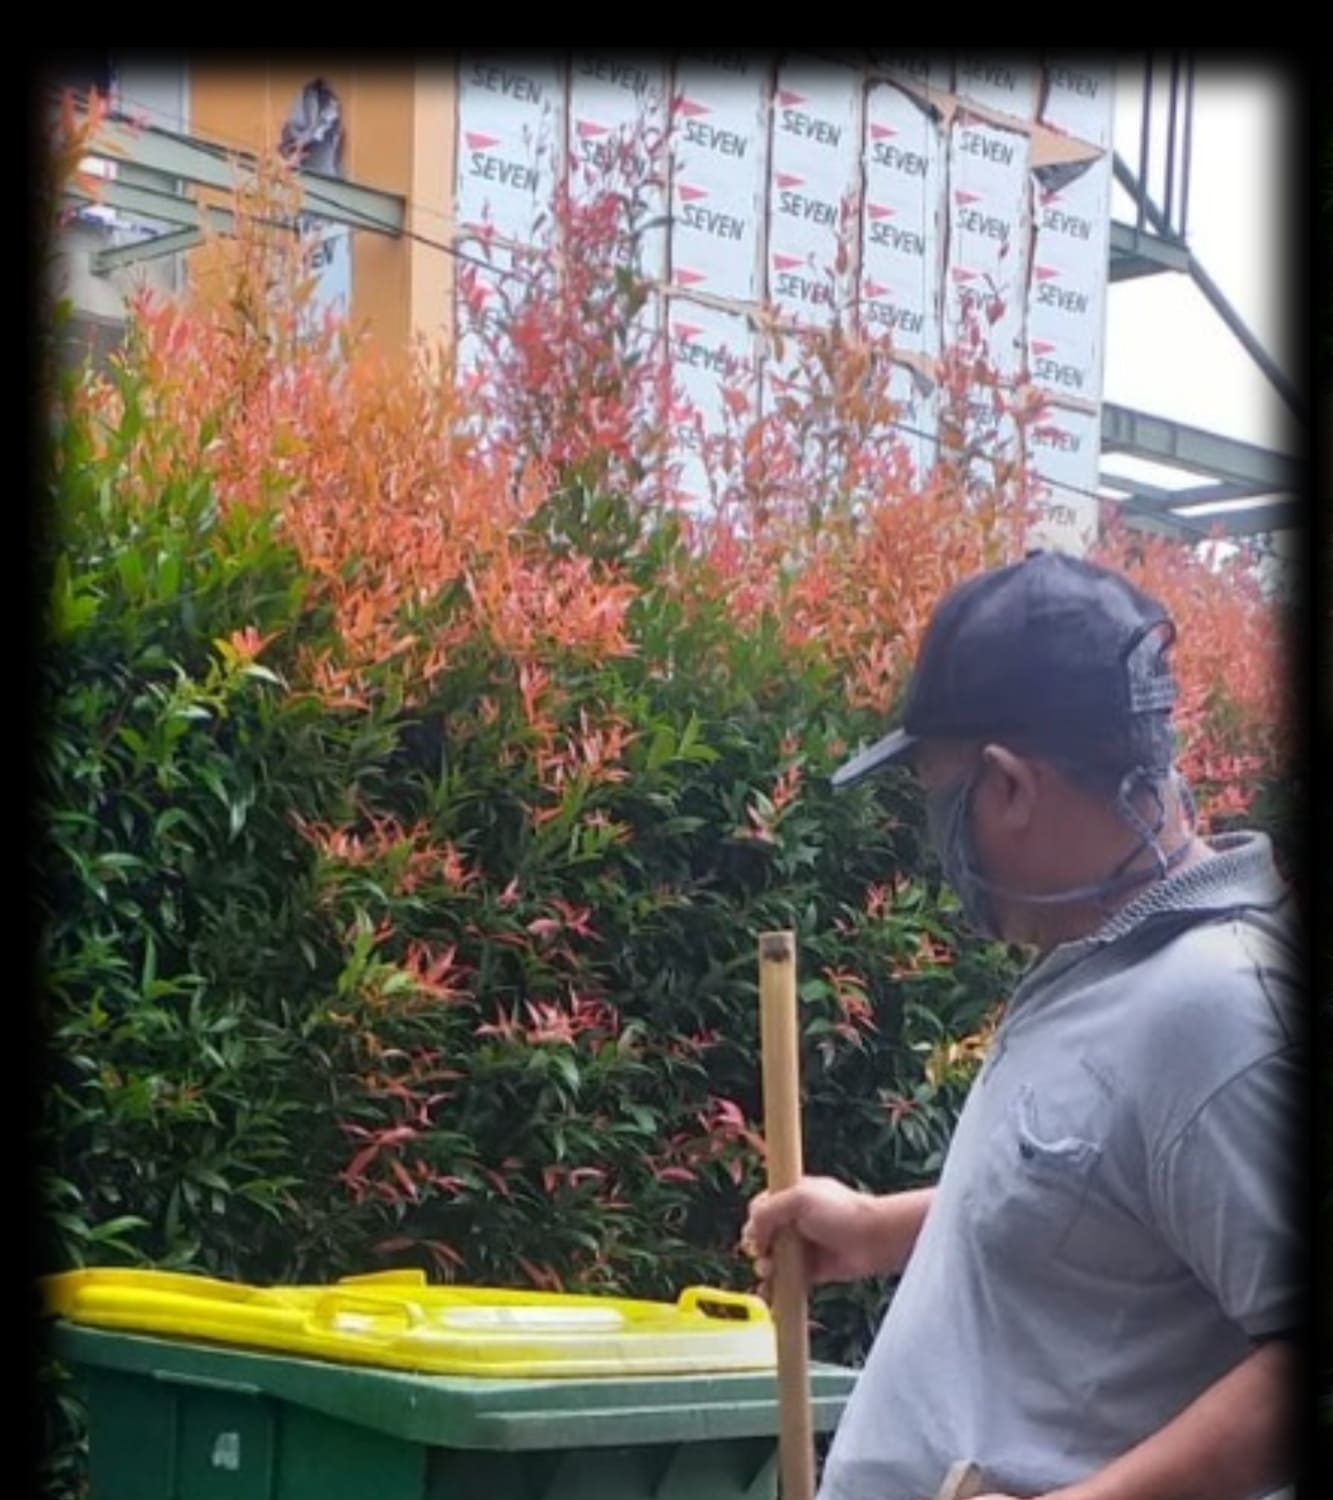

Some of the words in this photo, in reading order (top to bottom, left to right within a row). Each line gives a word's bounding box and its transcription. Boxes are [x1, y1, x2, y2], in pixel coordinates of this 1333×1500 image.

[472, 65, 542, 104] SEVEN
[684, 120, 748, 158] SEVEN
[779, 110, 841, 148] SEVEN
[871, 144, 929, 177] SEVEN
[960, 132, 1013, 166] SEVEN
[470, 153, 539, 189] SEVEN
[682, 204, 745, 240] SEVEN
[778, 191, 838, 225] SEVEN
[1041, 209, 1090, 240] SEVEN
[869, 222, 925, 255] SEVEN
[957, 209, 1010, 241] SEVEN
[1037, 284, 1087, 313] SEVEN
[867, 301, 923, 333] SEVEN
[1035, 358, 1082, 387] SEVEN
